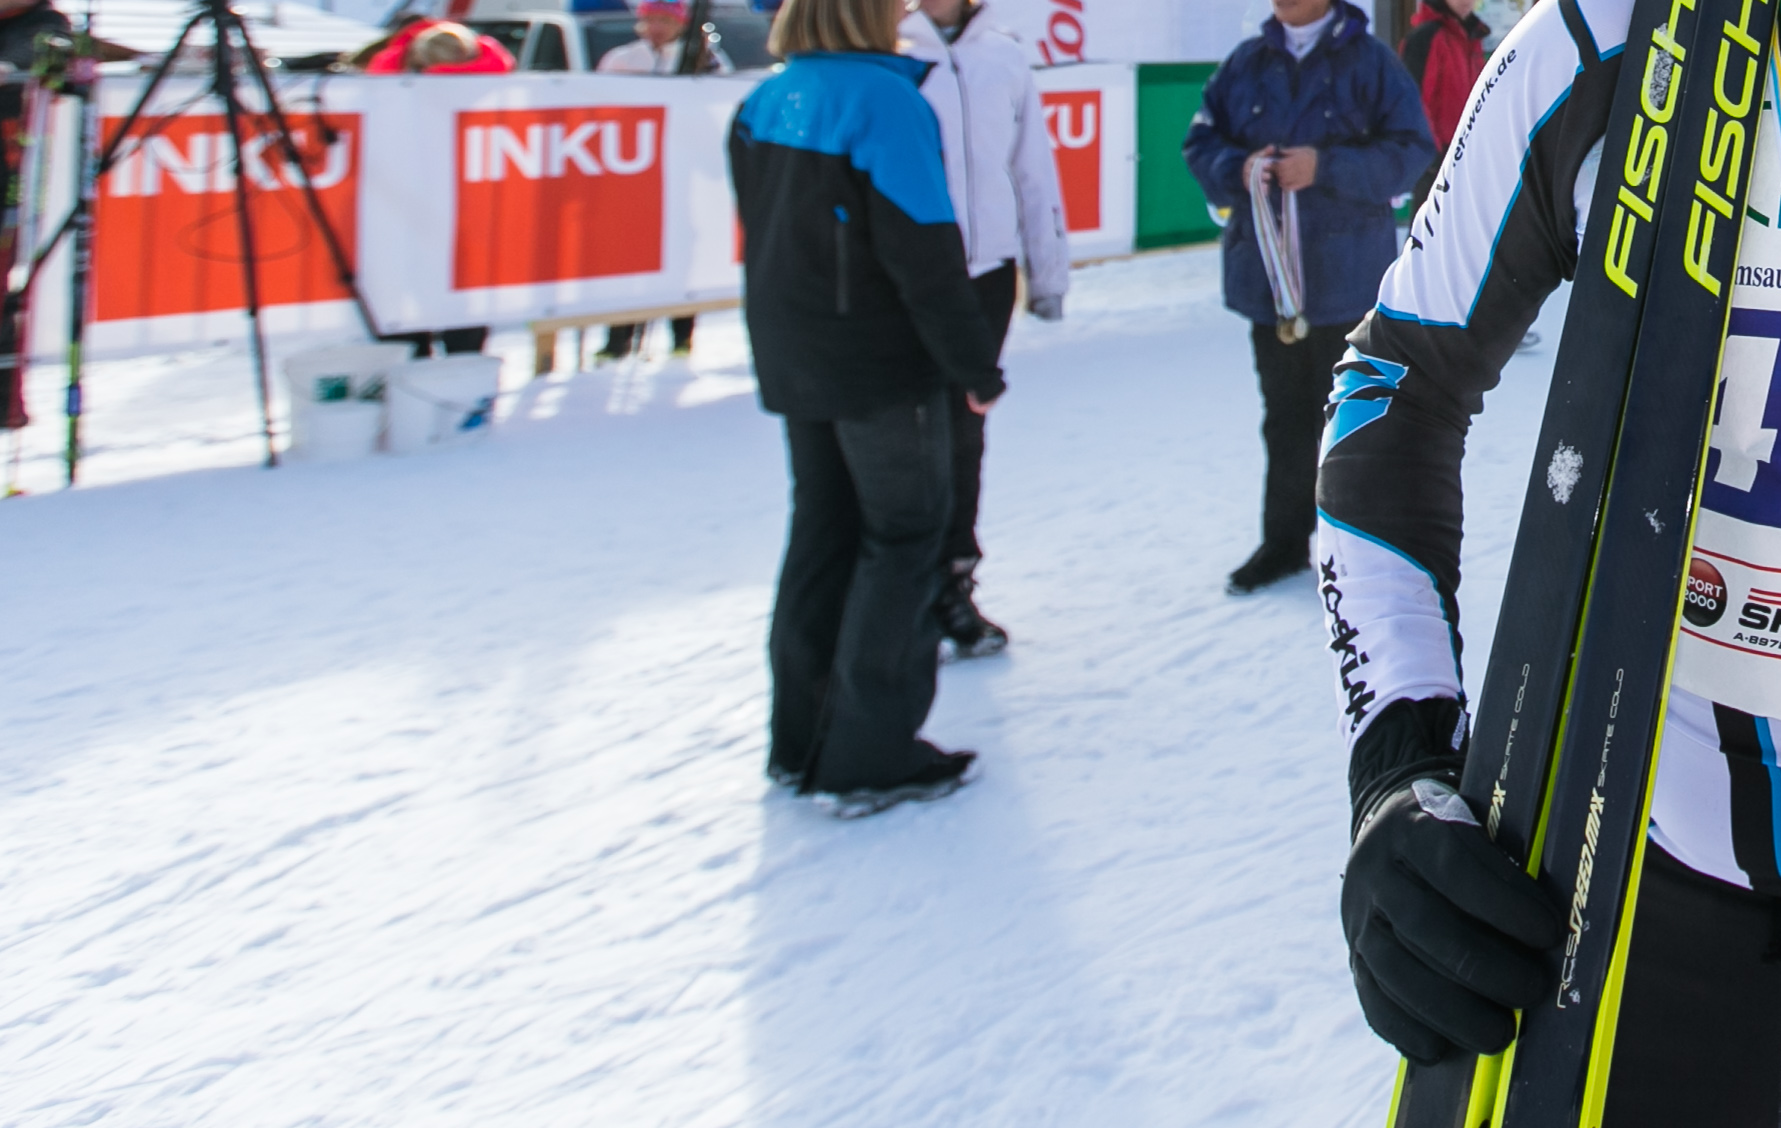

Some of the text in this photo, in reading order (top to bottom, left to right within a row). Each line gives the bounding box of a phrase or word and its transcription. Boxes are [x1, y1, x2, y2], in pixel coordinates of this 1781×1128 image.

[107, 128, 353, 199] INKU
[463, 119, 658, 183] INKU
[1514, 663, 1530, 714] COLD
[1609, 668, 1624, 719] COLD
